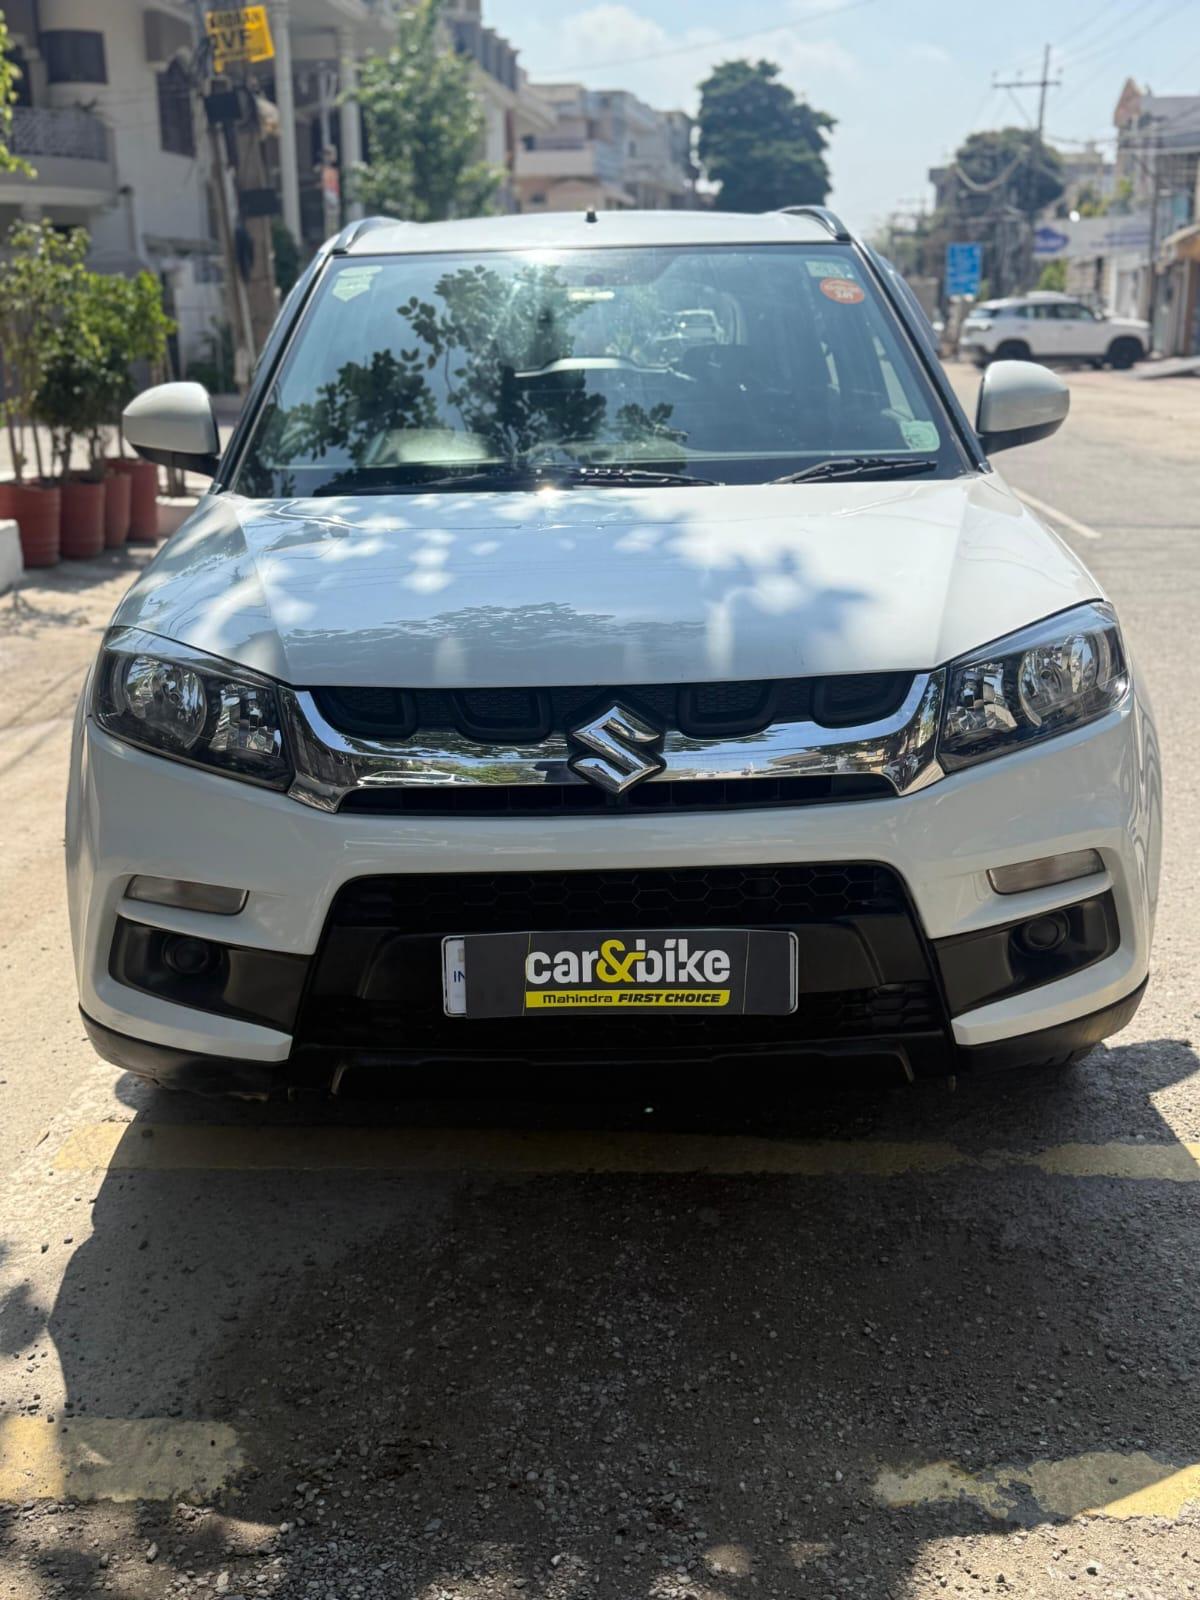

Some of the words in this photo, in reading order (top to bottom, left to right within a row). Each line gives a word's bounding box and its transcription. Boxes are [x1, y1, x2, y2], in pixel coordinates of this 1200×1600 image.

[525, 938, 731, 985] car&bike
[543, 993, 613, 1004] Mahindra
[618, 993, 663, 1003] FIRST
[664, 993, 721, 1003] CHOICE
